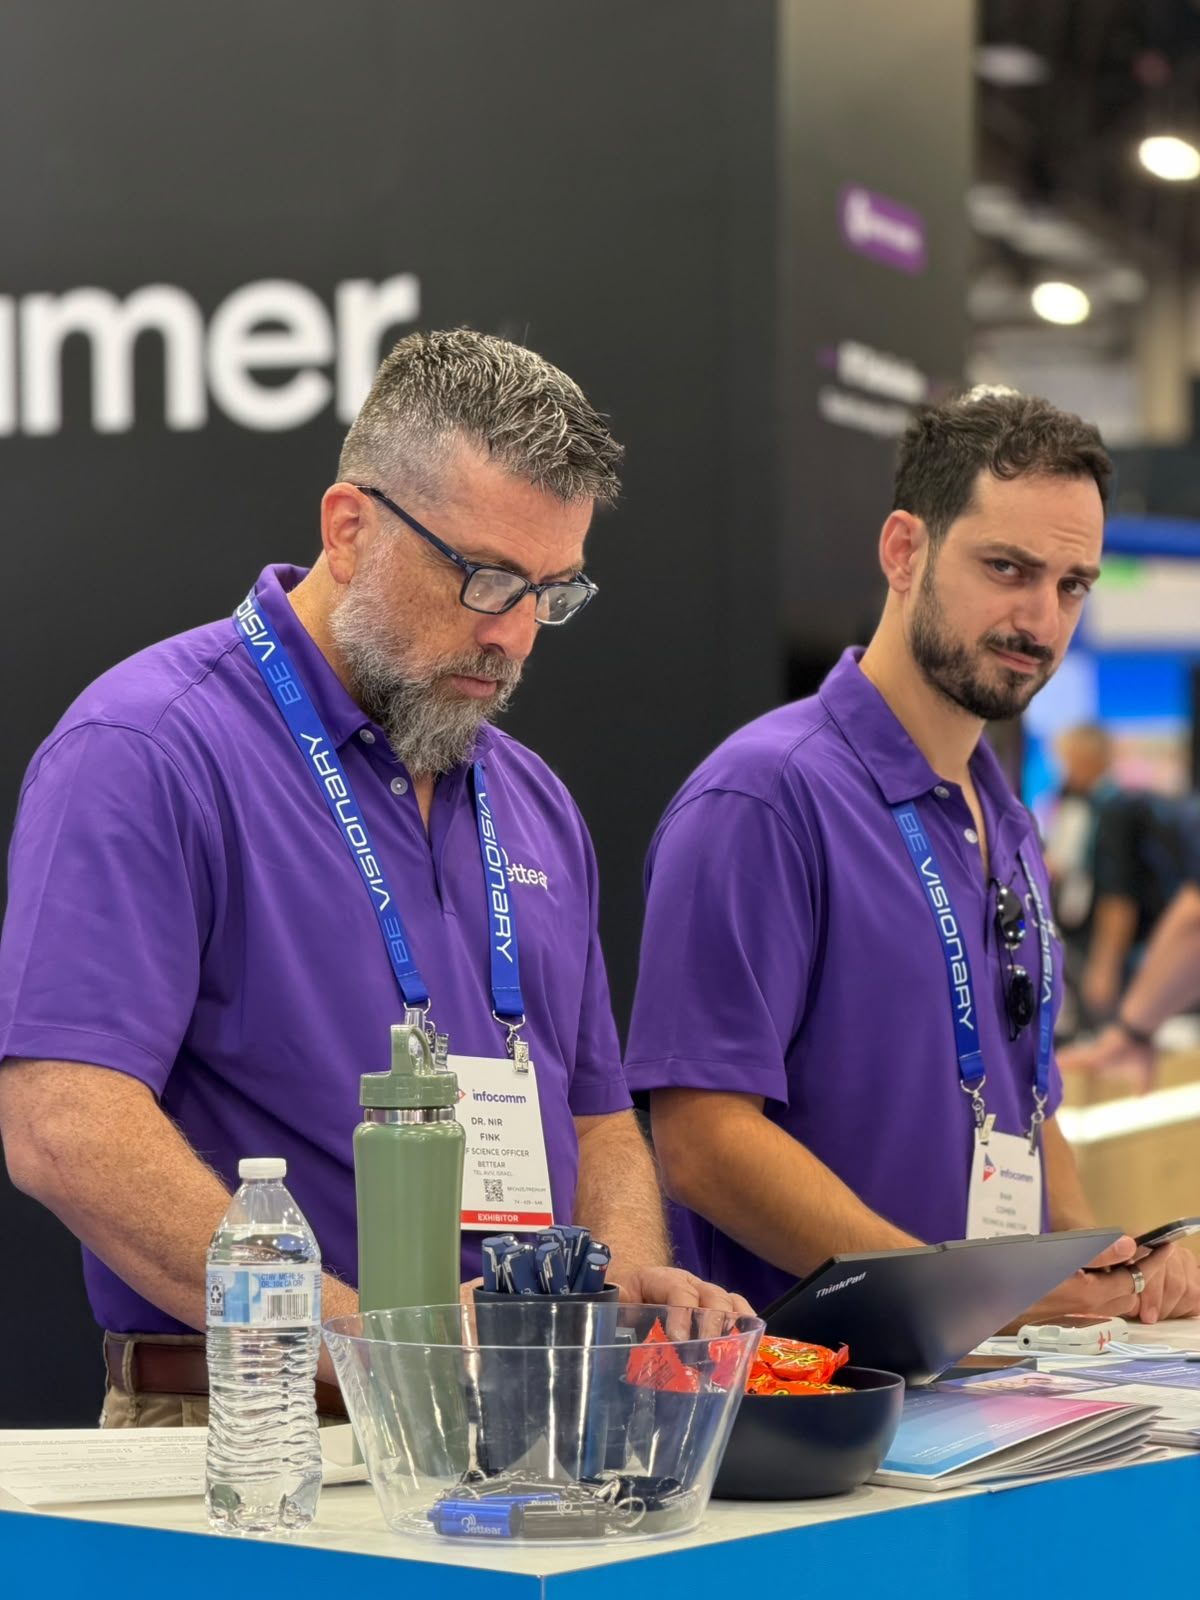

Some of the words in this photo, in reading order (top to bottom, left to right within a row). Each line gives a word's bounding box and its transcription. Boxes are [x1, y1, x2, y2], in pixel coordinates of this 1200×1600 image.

[0, 272, 420, 437] mer
[267, 661, 302, 705] BE
[900, 812, 927, 852] BE
[384, 917, 409, 964] BE
[472, 1089, 526, 1104] infocomm
[471, 1117, 486, 1126] DR.
[488, 1118, 503, 1127] NIR
[480, 1133, 500, 1142] FINK
[472, 1148, 500, 1156] SCIENCE
[478, 1160, 506, 1169] BETTEAR
[478, 1213, 519, 1222] EXHIBITOR
[815, 1271, 867, 1299] ThinkPad
